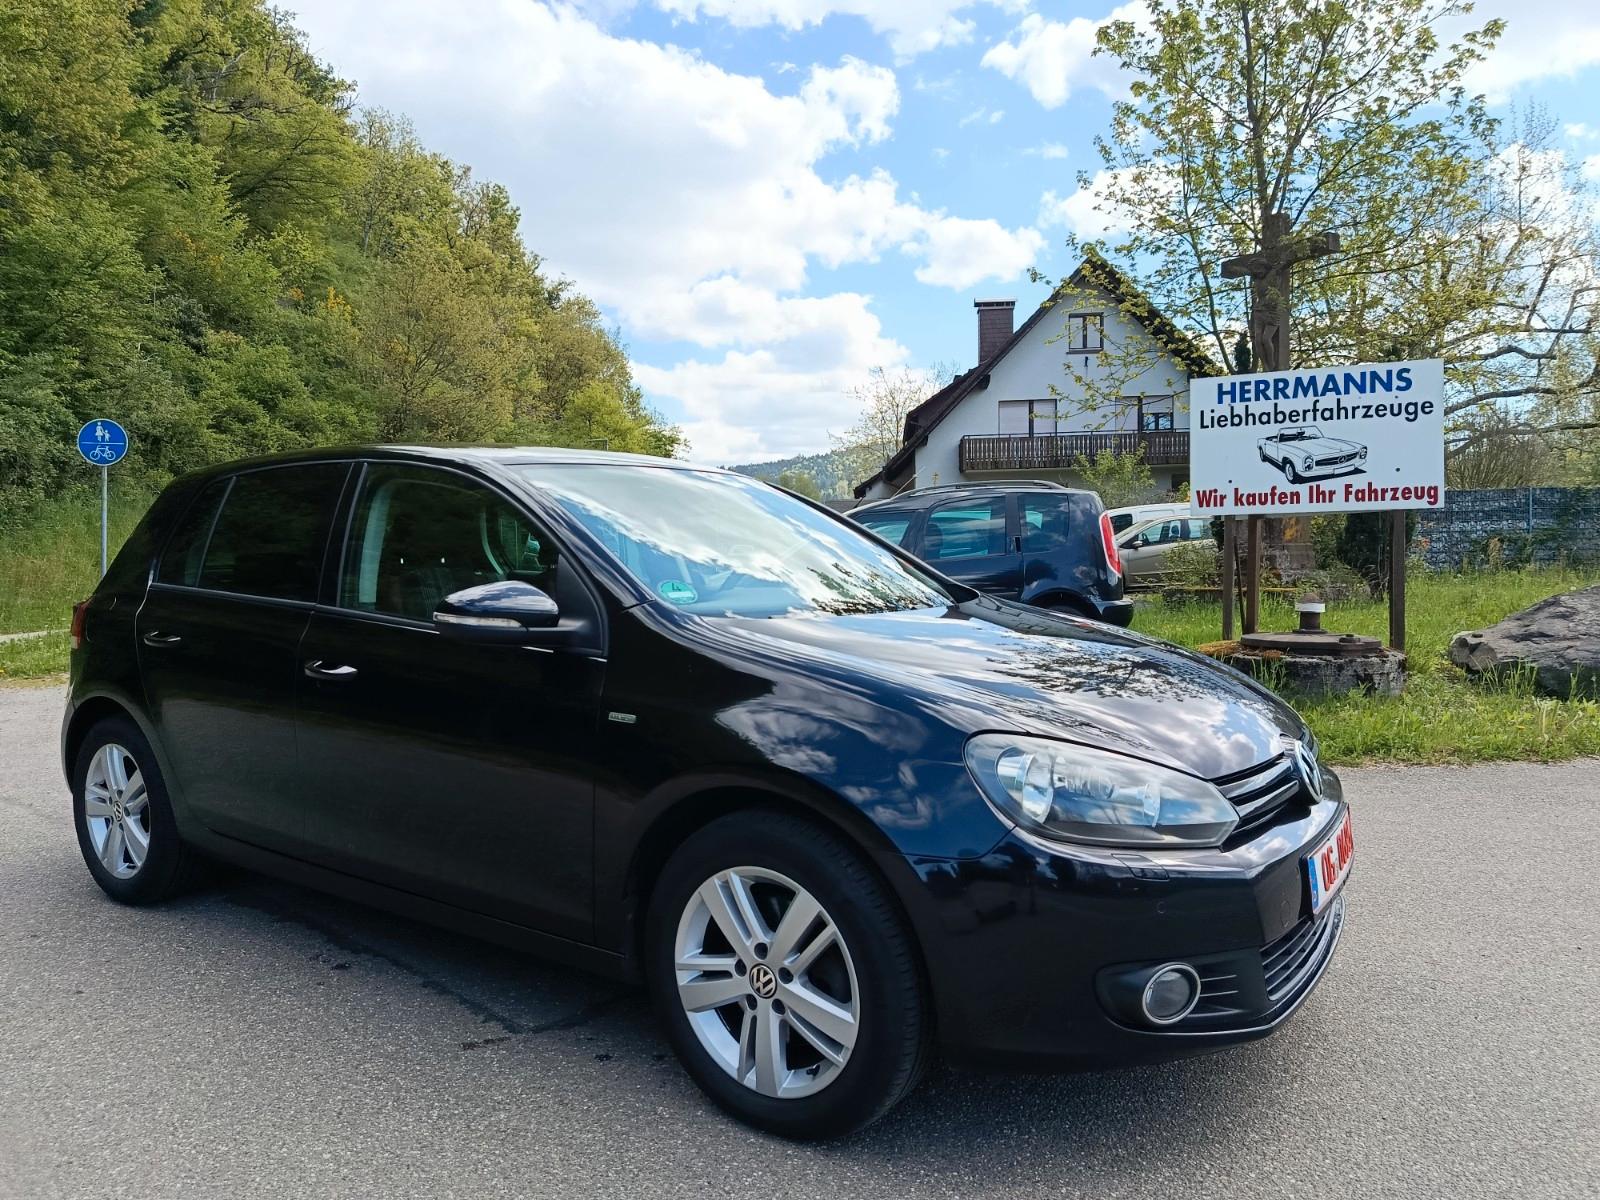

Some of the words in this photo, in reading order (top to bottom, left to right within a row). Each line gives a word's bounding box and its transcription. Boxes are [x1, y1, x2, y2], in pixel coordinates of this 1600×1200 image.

[1218, 368, 1413, 404] HERRMANNS
[1199, 399, 1435, 429] Liebhaberfahrzeuge
[1196, 488, 1228, 508] Wir
[1233, 485, 1301, 507] kaufen
[1308, 484, 1336, 504] Ihr
[1343, 481, 1439, 505] Fahrzeug
[750, 963, 777, 998] VW
